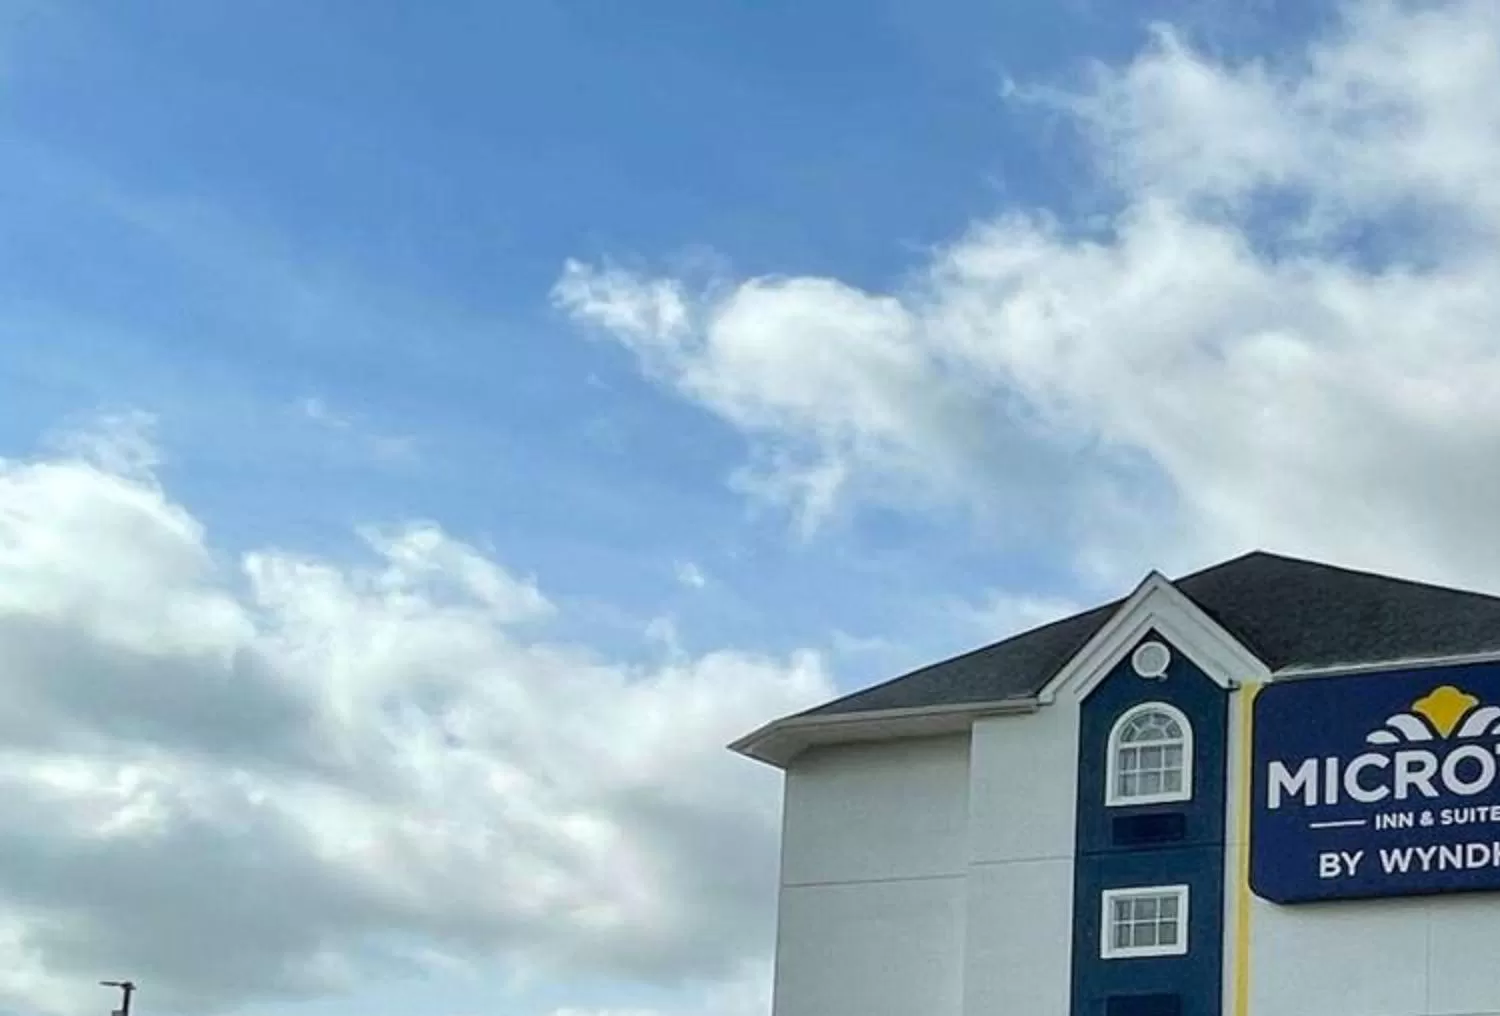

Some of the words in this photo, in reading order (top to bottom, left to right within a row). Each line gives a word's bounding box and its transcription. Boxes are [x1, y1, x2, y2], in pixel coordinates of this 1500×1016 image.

[1376, 811, 1414, 830] INN
[1419, 809, 1434, 827] &
[1319, 850, 1364, 878] BY
